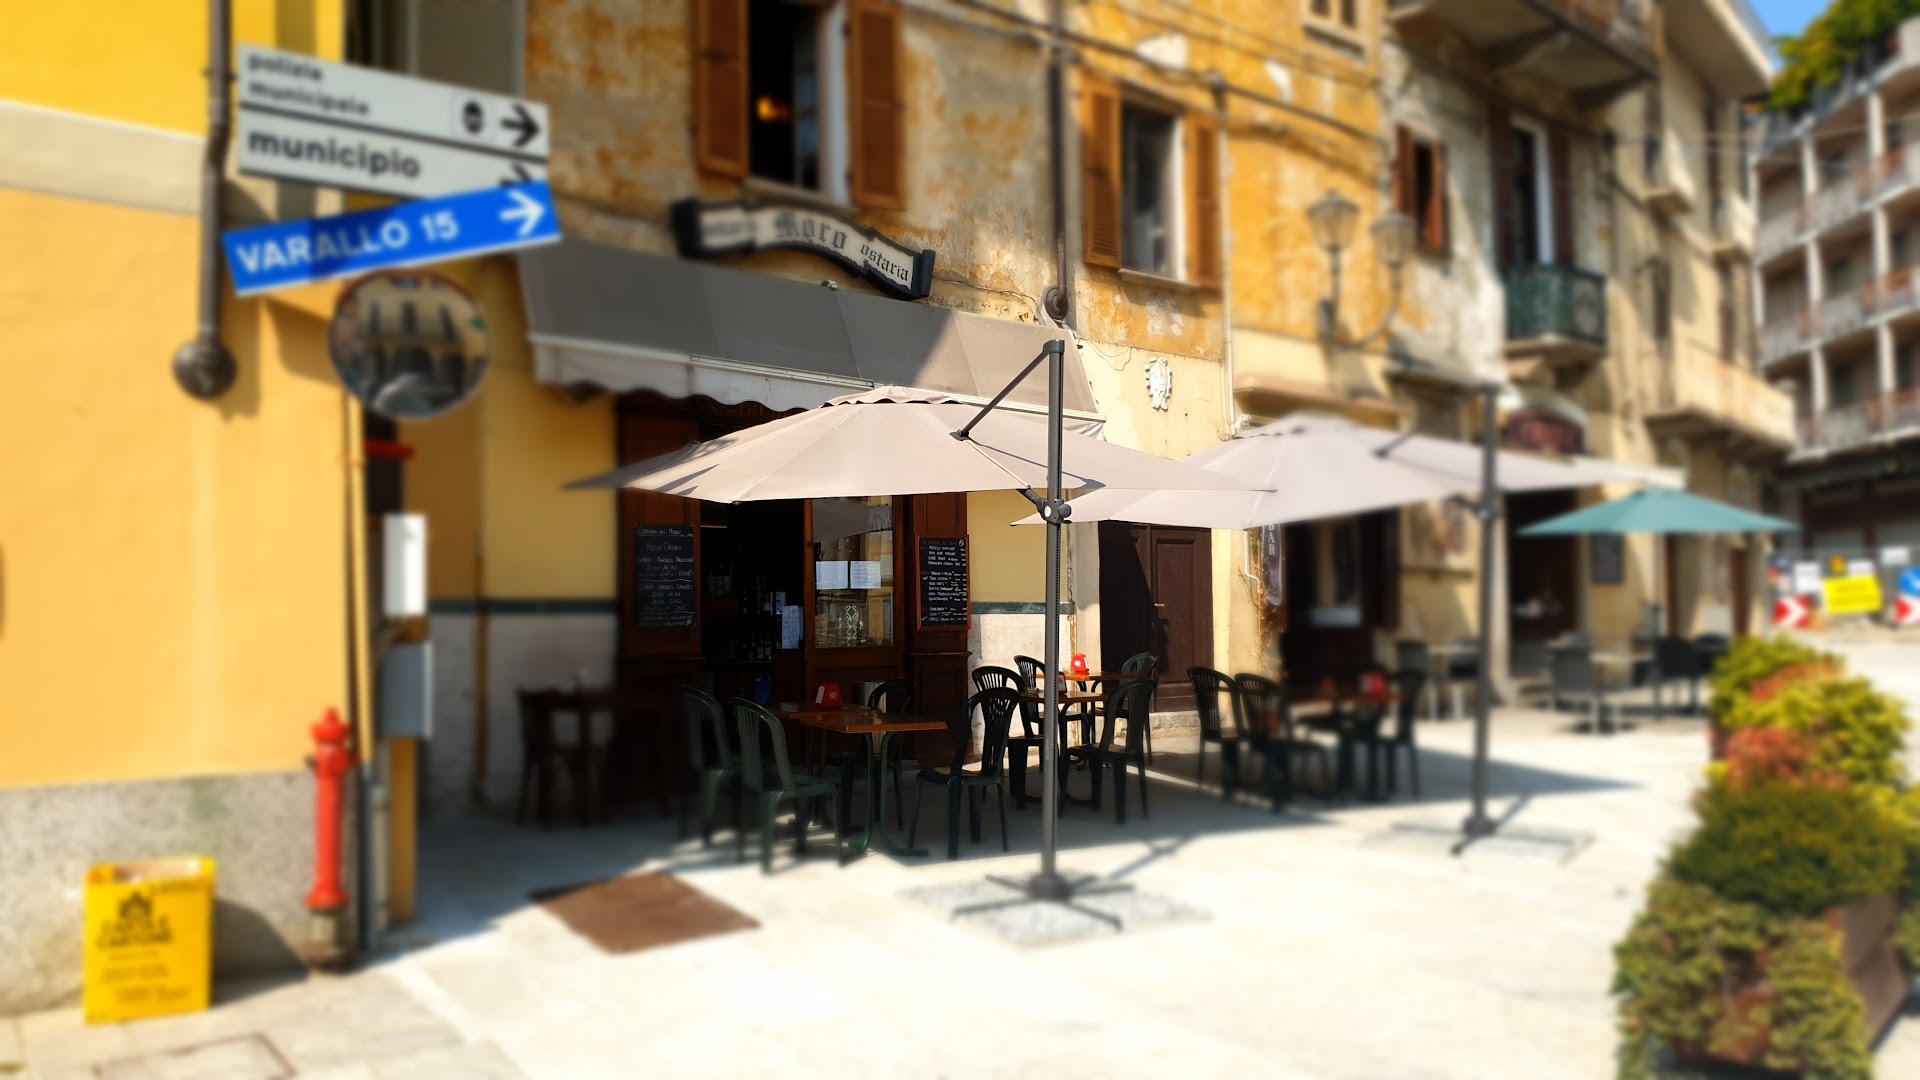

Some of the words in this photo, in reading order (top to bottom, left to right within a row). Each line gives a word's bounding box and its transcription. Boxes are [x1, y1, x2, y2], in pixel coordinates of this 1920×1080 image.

[248, 53, 322, 83] polizia
[248, 79, 369, 116] municipale
[248, 129, 421, 180] municipio
[235, 219, 410, 276] VARALLO
[420, 210, 459, 242] 15
[774, 211, 848, 251] Moro
[860, 243, 910, 282] ostaria
